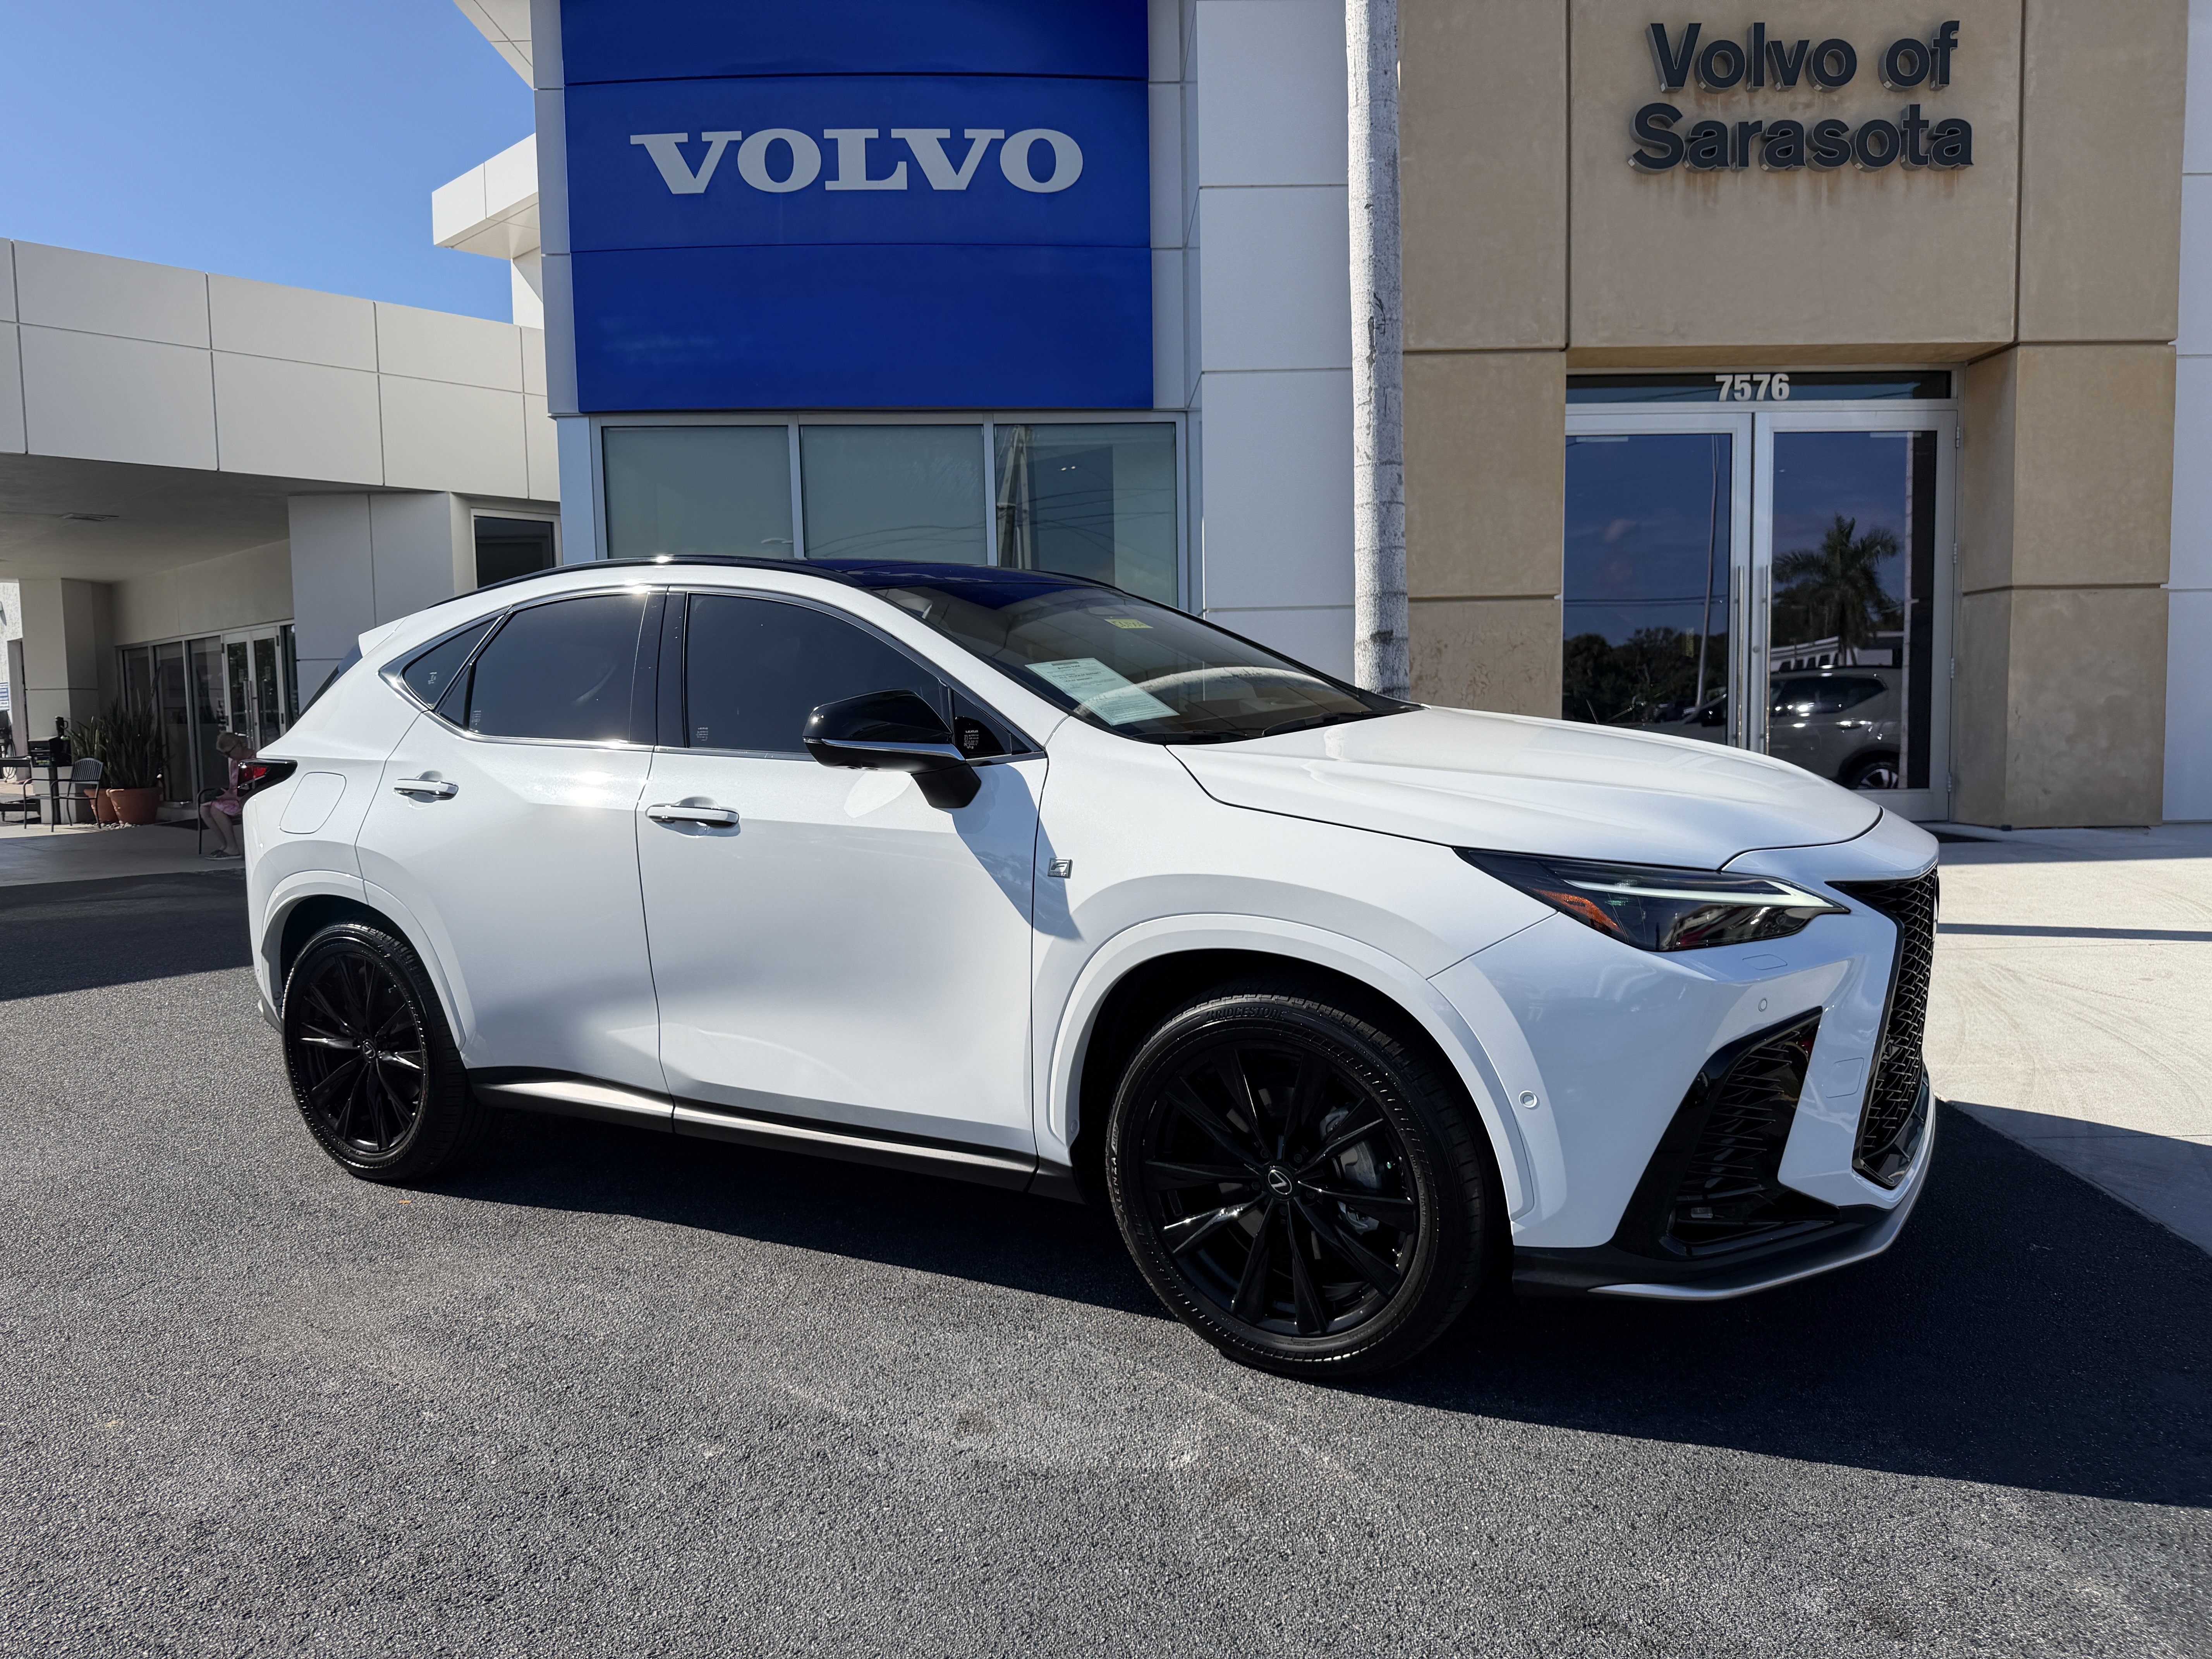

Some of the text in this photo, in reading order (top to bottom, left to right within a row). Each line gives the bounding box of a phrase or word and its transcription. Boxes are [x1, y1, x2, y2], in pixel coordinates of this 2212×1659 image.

[1645, 20, 1960, 93] Volvo of
[630, 128, 1084, 194] VOLVO
[1628, 103, 1974, 173] Sarasota
[1715, 373, 1790, 402] 7576
[1206, 1006, 1287, 1023] BRIDGESTONE
[1111, 1157, 1124, 1212] ALENZA
